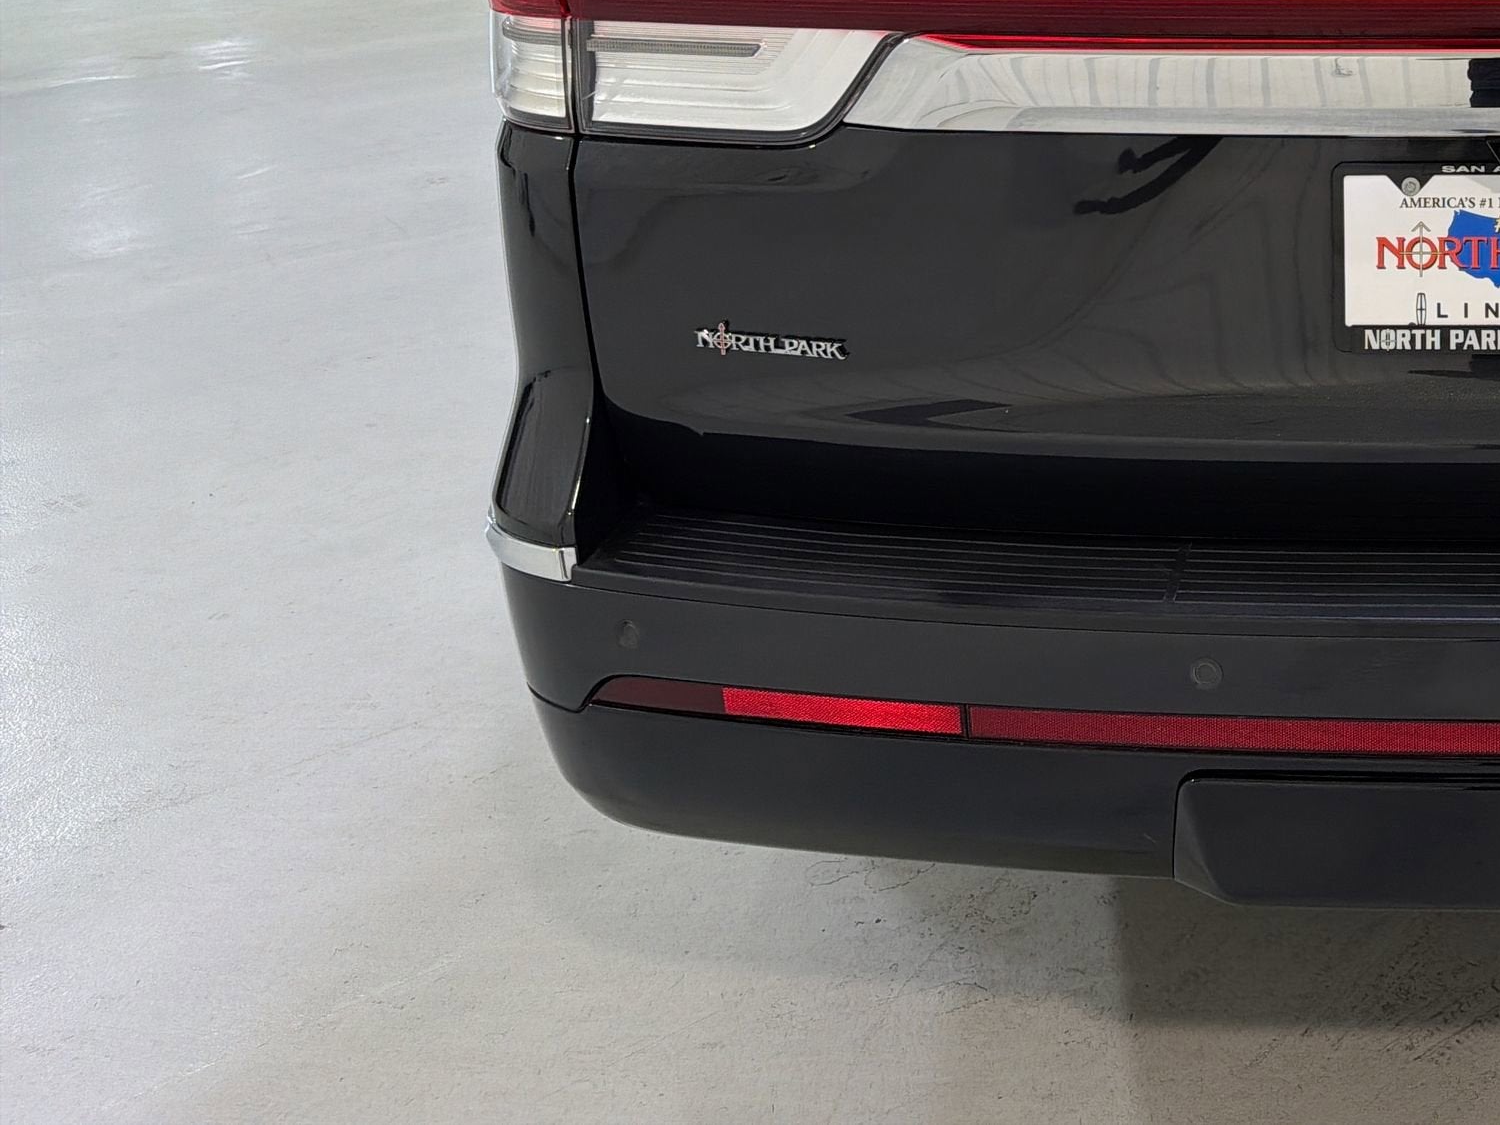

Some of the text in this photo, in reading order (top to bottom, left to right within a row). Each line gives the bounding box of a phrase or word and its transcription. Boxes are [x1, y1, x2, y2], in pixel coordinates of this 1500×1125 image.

[1441, 165, 1486, 173] SAN
[1400, 197, 1476, 209] AMERICA'S
[1480, 197, 1493, 209] #1
[694, 329, 849, 360] NORTH PARK
[1364, 328, 1442, 351] NORTH
